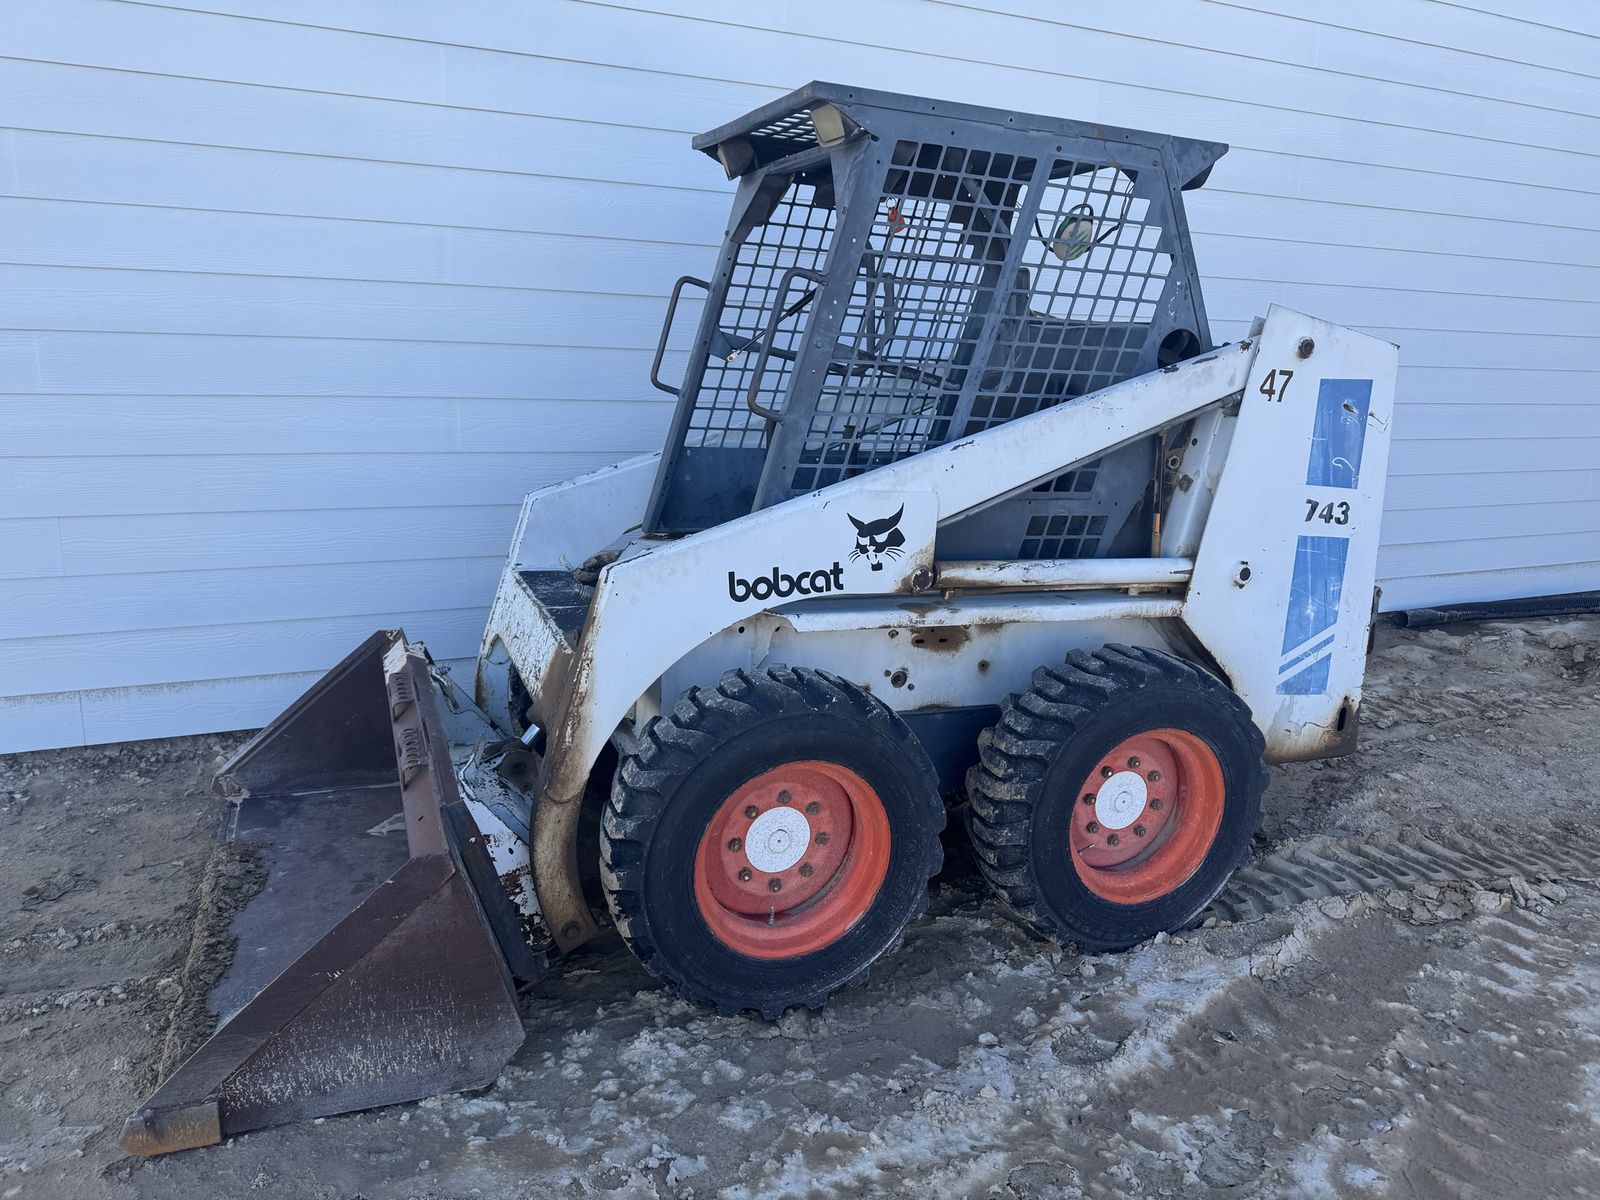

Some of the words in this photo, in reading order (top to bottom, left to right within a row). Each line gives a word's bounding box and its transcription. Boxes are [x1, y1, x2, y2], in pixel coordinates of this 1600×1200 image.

[1259, 369, 1294, 403] 47
[1305, 499, 1350, 525] 743
[728, 561, 844, 602] bobcat
